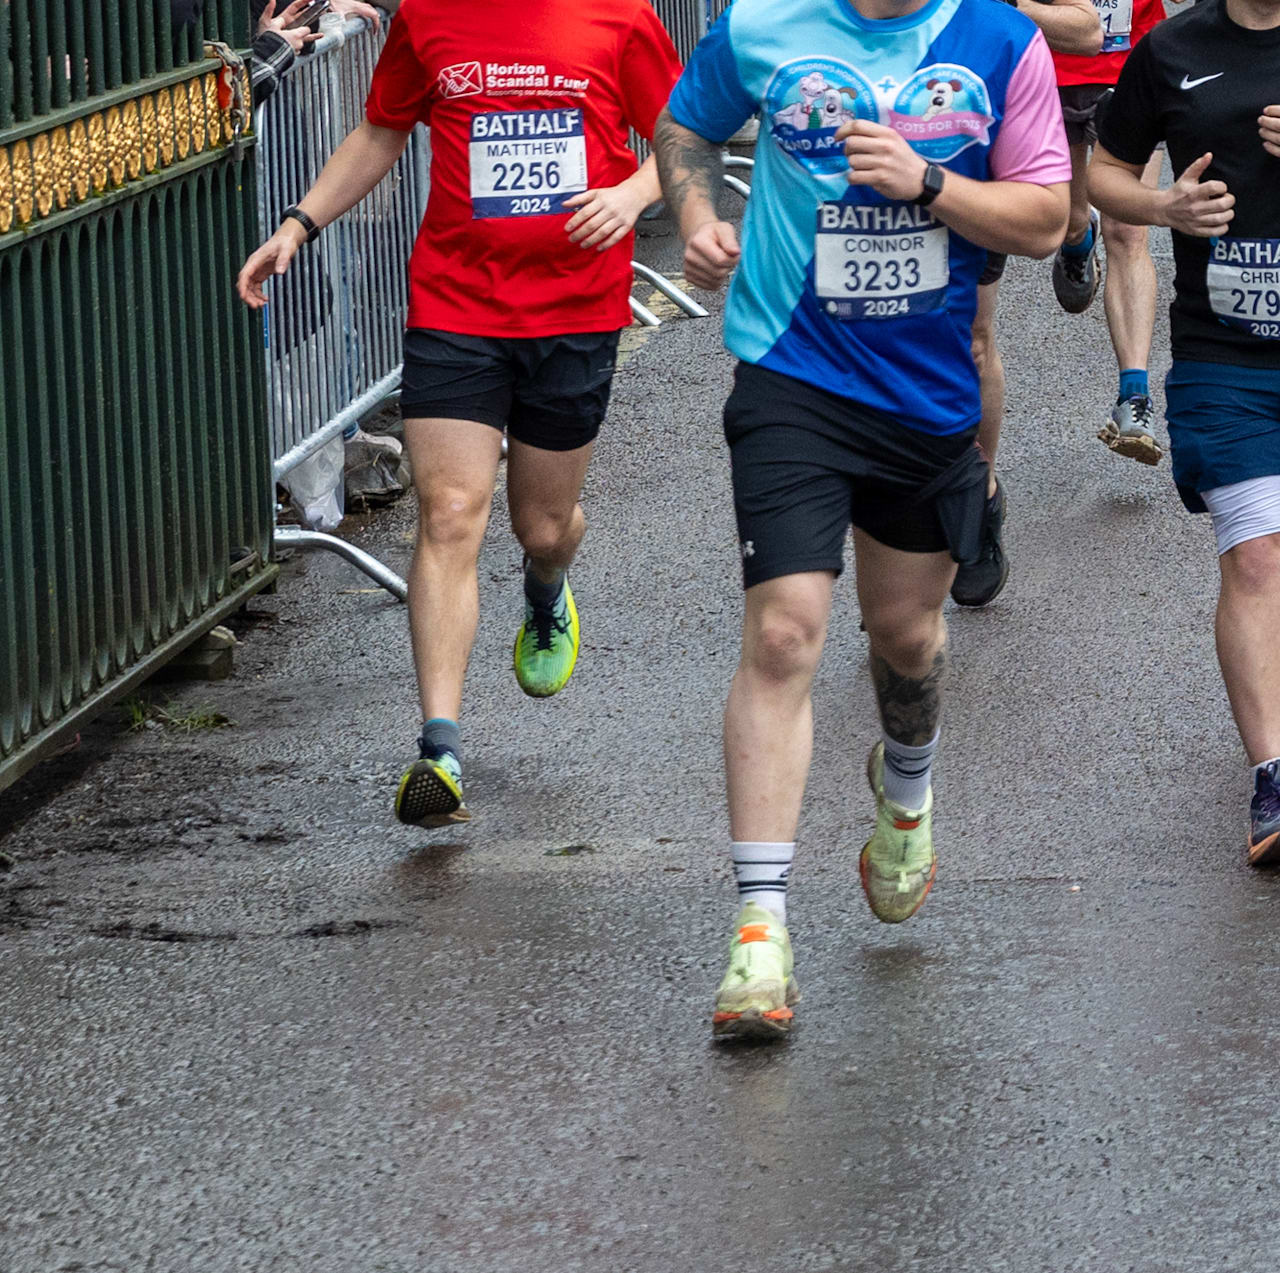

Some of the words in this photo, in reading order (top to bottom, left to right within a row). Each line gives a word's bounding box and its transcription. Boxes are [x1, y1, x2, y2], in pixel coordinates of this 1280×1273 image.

[486, 63, 546, 75] Horizon
[486, 75, 550, 88] Scandal
[553, 75, 590, 89] Fund
[472, 110, 580, 138] BATHALF
[895, 121, 925, 133] COTS
[928, 119, 953, 132] FOR
[954, 119, 981, 130] TOTS
[486, 141, 569, 158] MATTHEW
[492, 161, 561, 192] 2256
[510, 198, 551, 214] 2024
[821, 204, 936, 230] BATHAL
[844, 236, 926, 253] CONNOR
[844, 257, 921, 293] 3233
[863, 298, 910, 316] 2024
